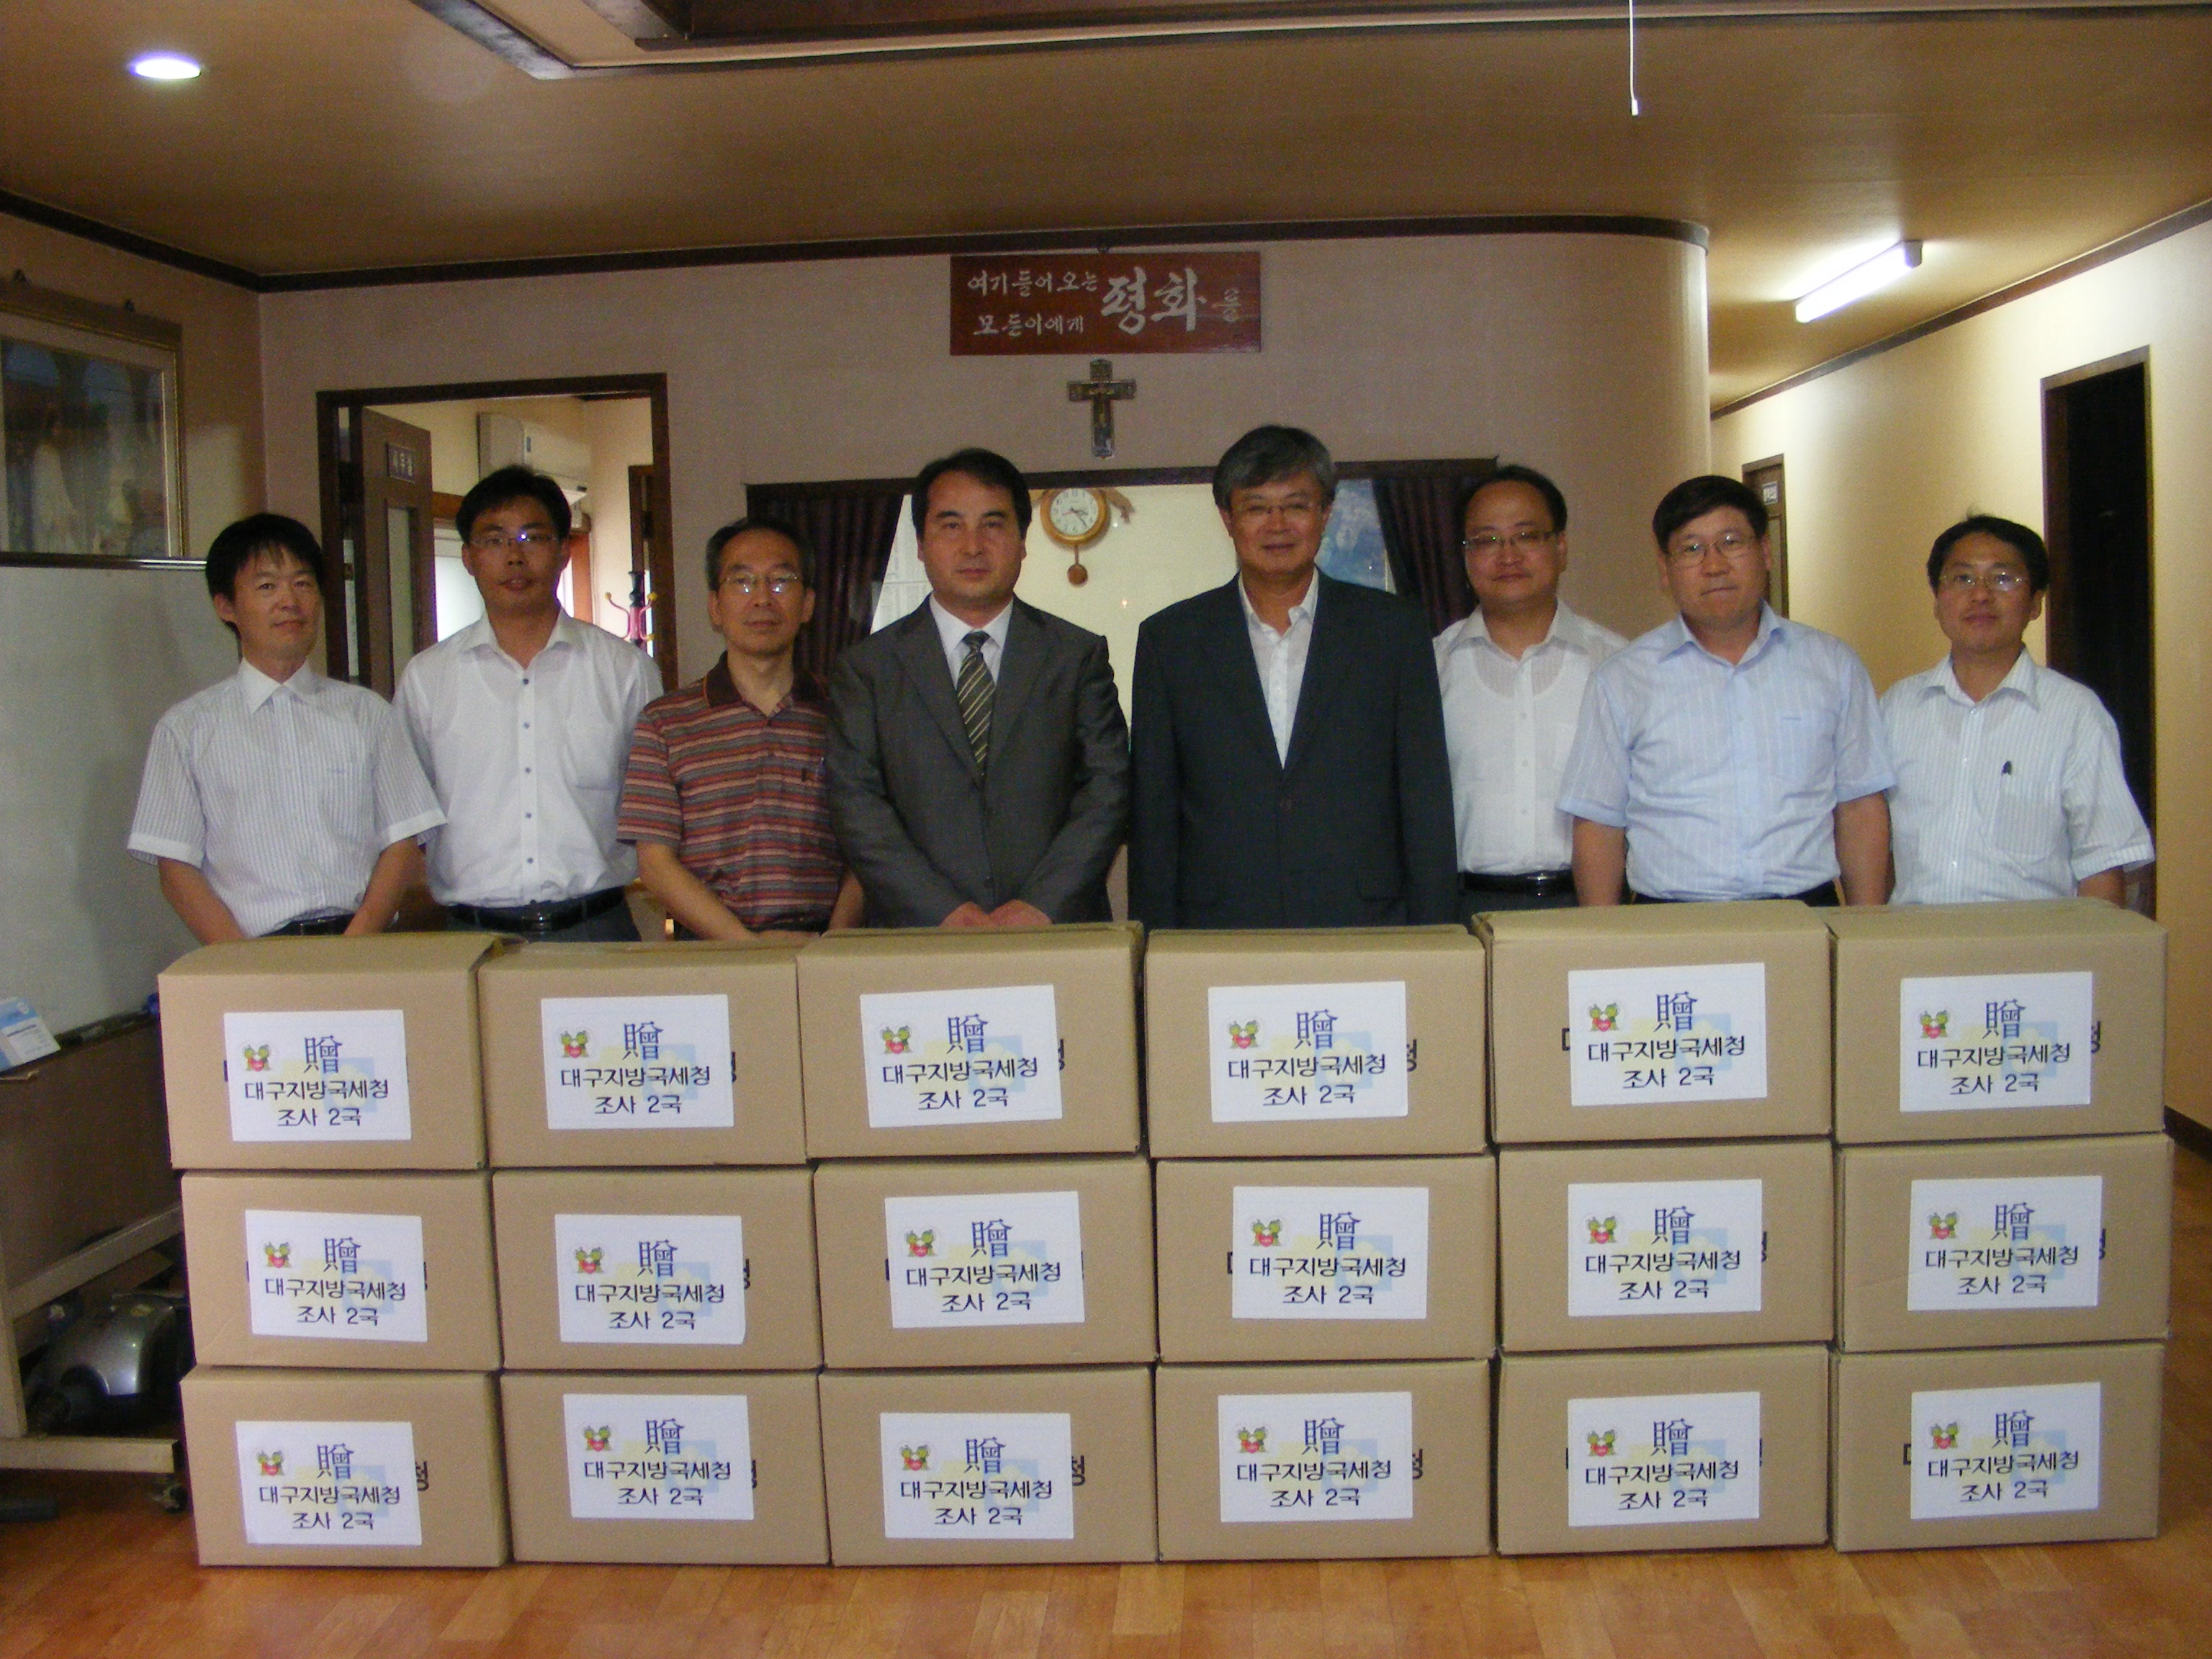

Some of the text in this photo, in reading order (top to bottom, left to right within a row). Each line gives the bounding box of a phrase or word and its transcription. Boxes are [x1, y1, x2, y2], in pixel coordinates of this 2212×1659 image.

[1654, 991, 1699, 1032] 贈
[1982, 999, 2026, 1039] 贈
[622, 1020, 664, 1061] 贈
[946, 1013, 989, 1054] 贈
[1294, 1009, 1339, 1050] 贈
[303, 1035, 343, 1074] 贈
[1588, 1035, 1745, 1063] 대구지방국세청
[1917, 1042, 2070, 1069] 대구지방국세청
[560, 1065, 711, 1088] 대구지방국세청
[882, 1056, 1038, 1084] 대구지방국세청
[1228, 1053, 1386, 1079] 대구지방국세청
[1623, 1066, 1714, 1089] 조사 2국
[244, 1079, 389, 1101] 대구지방국세청
[1263, 1084, 1355, 1106] 조사 2국
[1950, 1072, 2039, 1095] 조사 2국
[595, 1094, 681, 1115] 조사 2국
[919, 1087, 1008, 1110] 조사 2국
[278, 1107, 361, 1128] 조사 2국
[1316, 1211, 1361, 1251] 贈
[1651, 1205, 1696, 1246] 贈
[1991, 1202, 2036, 1241] 贈
[970, 1218, 1013, 1259] 贈
[323, 1236, 361, 1274] 贈
[637, 1239, 678, 1278] 贈
[1249, 1256, 1406, 1277] 대구지방국세청
[1586, 1249, 1740, 1274] 대구지방국세청
[1925, 1245, 2079, 1269] 대구지방국세청
[906, 1262, 1061, 1287] 대구지방국세청
[1957, 1274, 2047, 1295] 조사 2국
[264, 1277, 406, 1301] 대구지방국세청
[575, 1283, 724, 1304] 대구지방국세청
[1282, 1285, 1374, 1305] 조사 2국
[1619, 1279, 1709, 1300] 조사 2국
[942, 1291, 1031, 1313] 조사 2국
[297, 1305, 379, 1327] 조사 2국
[609, 1310, 696, 1331] 조사 2국
[644, 1418, 685, 1455] 贈
[1301, 1417, 1345, 1456] 贈
[1650, 1418, 1694, 1457] 贈
[1992, 1409, 2036, 1449] 贈
[317, 1443, 355, 1480] 贈
[963, 1437, 1006, 1475] 贈
[1928, 1449, 2079, 1478] 대구지방국세청
[584, 1460, 731, 1480] 대구지방국세청
[1236, 1460, 1391, 1483] 대구지방국세청
[1585, 1460, 1739, 1485] 대구지방국세청
[258, 1485, 400, 1505] 대구지방국세청
[618, 1487, 703, 1506] 조사 2국
[900, 1480, 1052, 1500] 대구지방국세청
[1270, 1488, 1360, 1508] 조사 2국
[1619, 1488, 1708, 1511] 조사 2국
[1960, 1479, 2049, 1503] 조사 2국
[292, 1511, 374, 1531] 조사 2국
[935, 1506, 1022, 1526] 조사 2국
